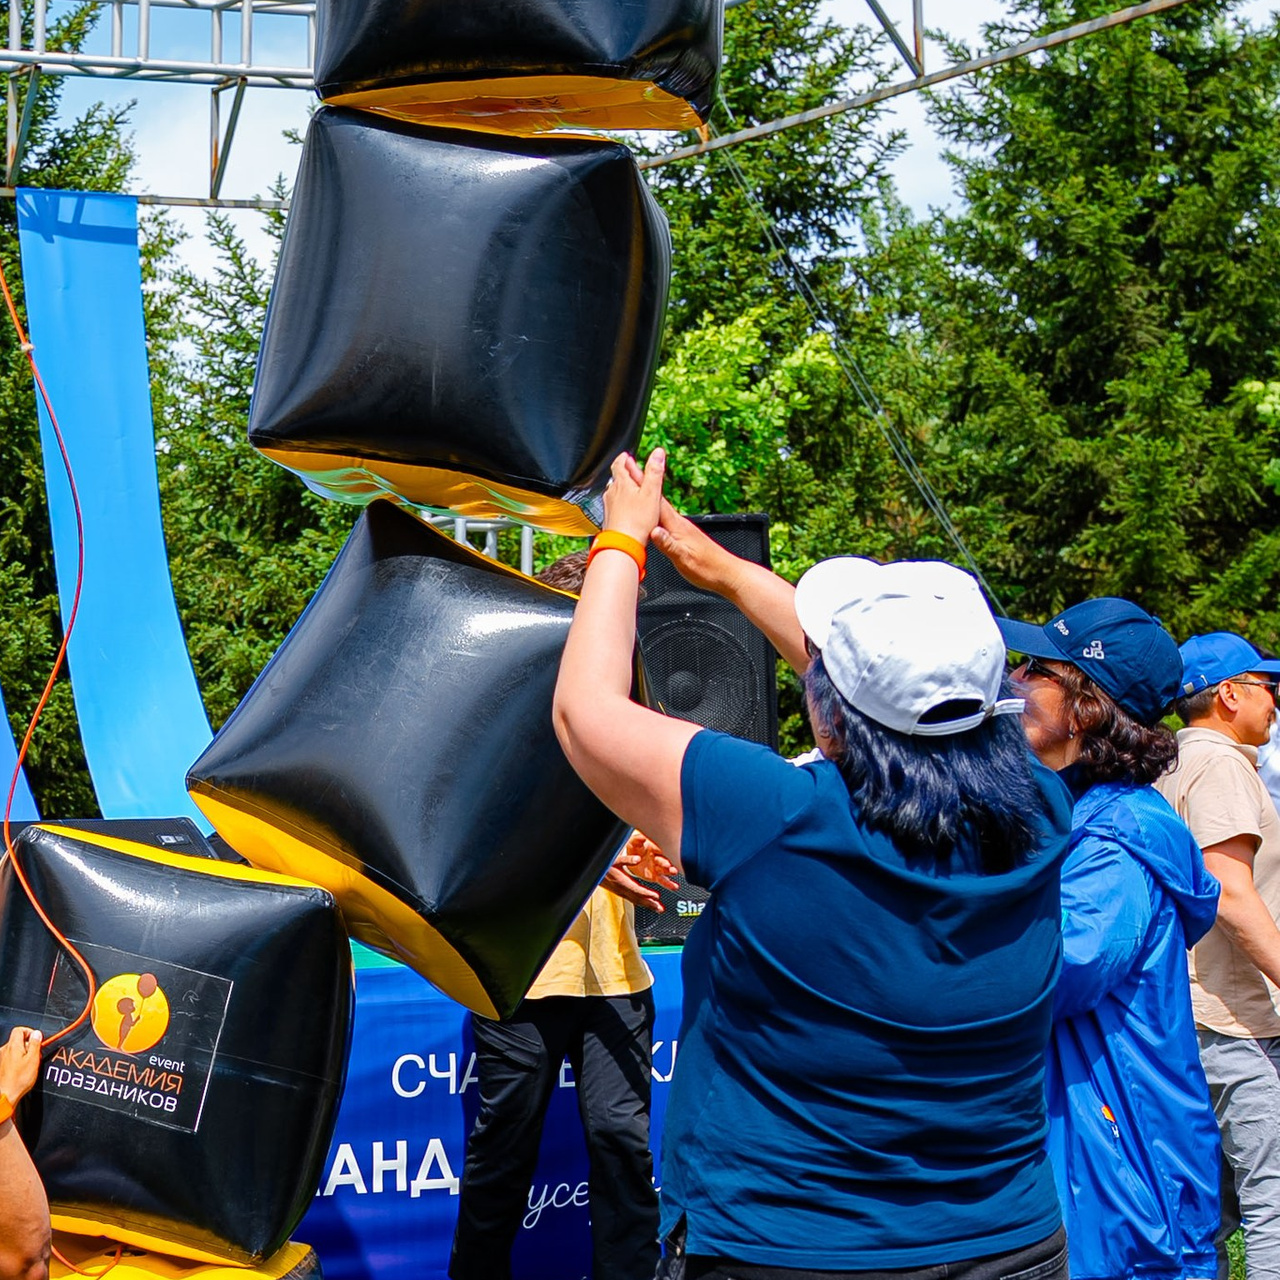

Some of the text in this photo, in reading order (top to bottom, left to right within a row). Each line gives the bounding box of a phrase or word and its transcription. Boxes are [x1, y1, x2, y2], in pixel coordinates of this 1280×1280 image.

[676, 900, 706, 913] Sha
[51, 1046, 184, 1095] АКАДЕМИЯ
[148, 1054, 186, 1074] event
[46, 1065, 178, 1113] праздников
[316, 1138, 460, 1198] АНД
